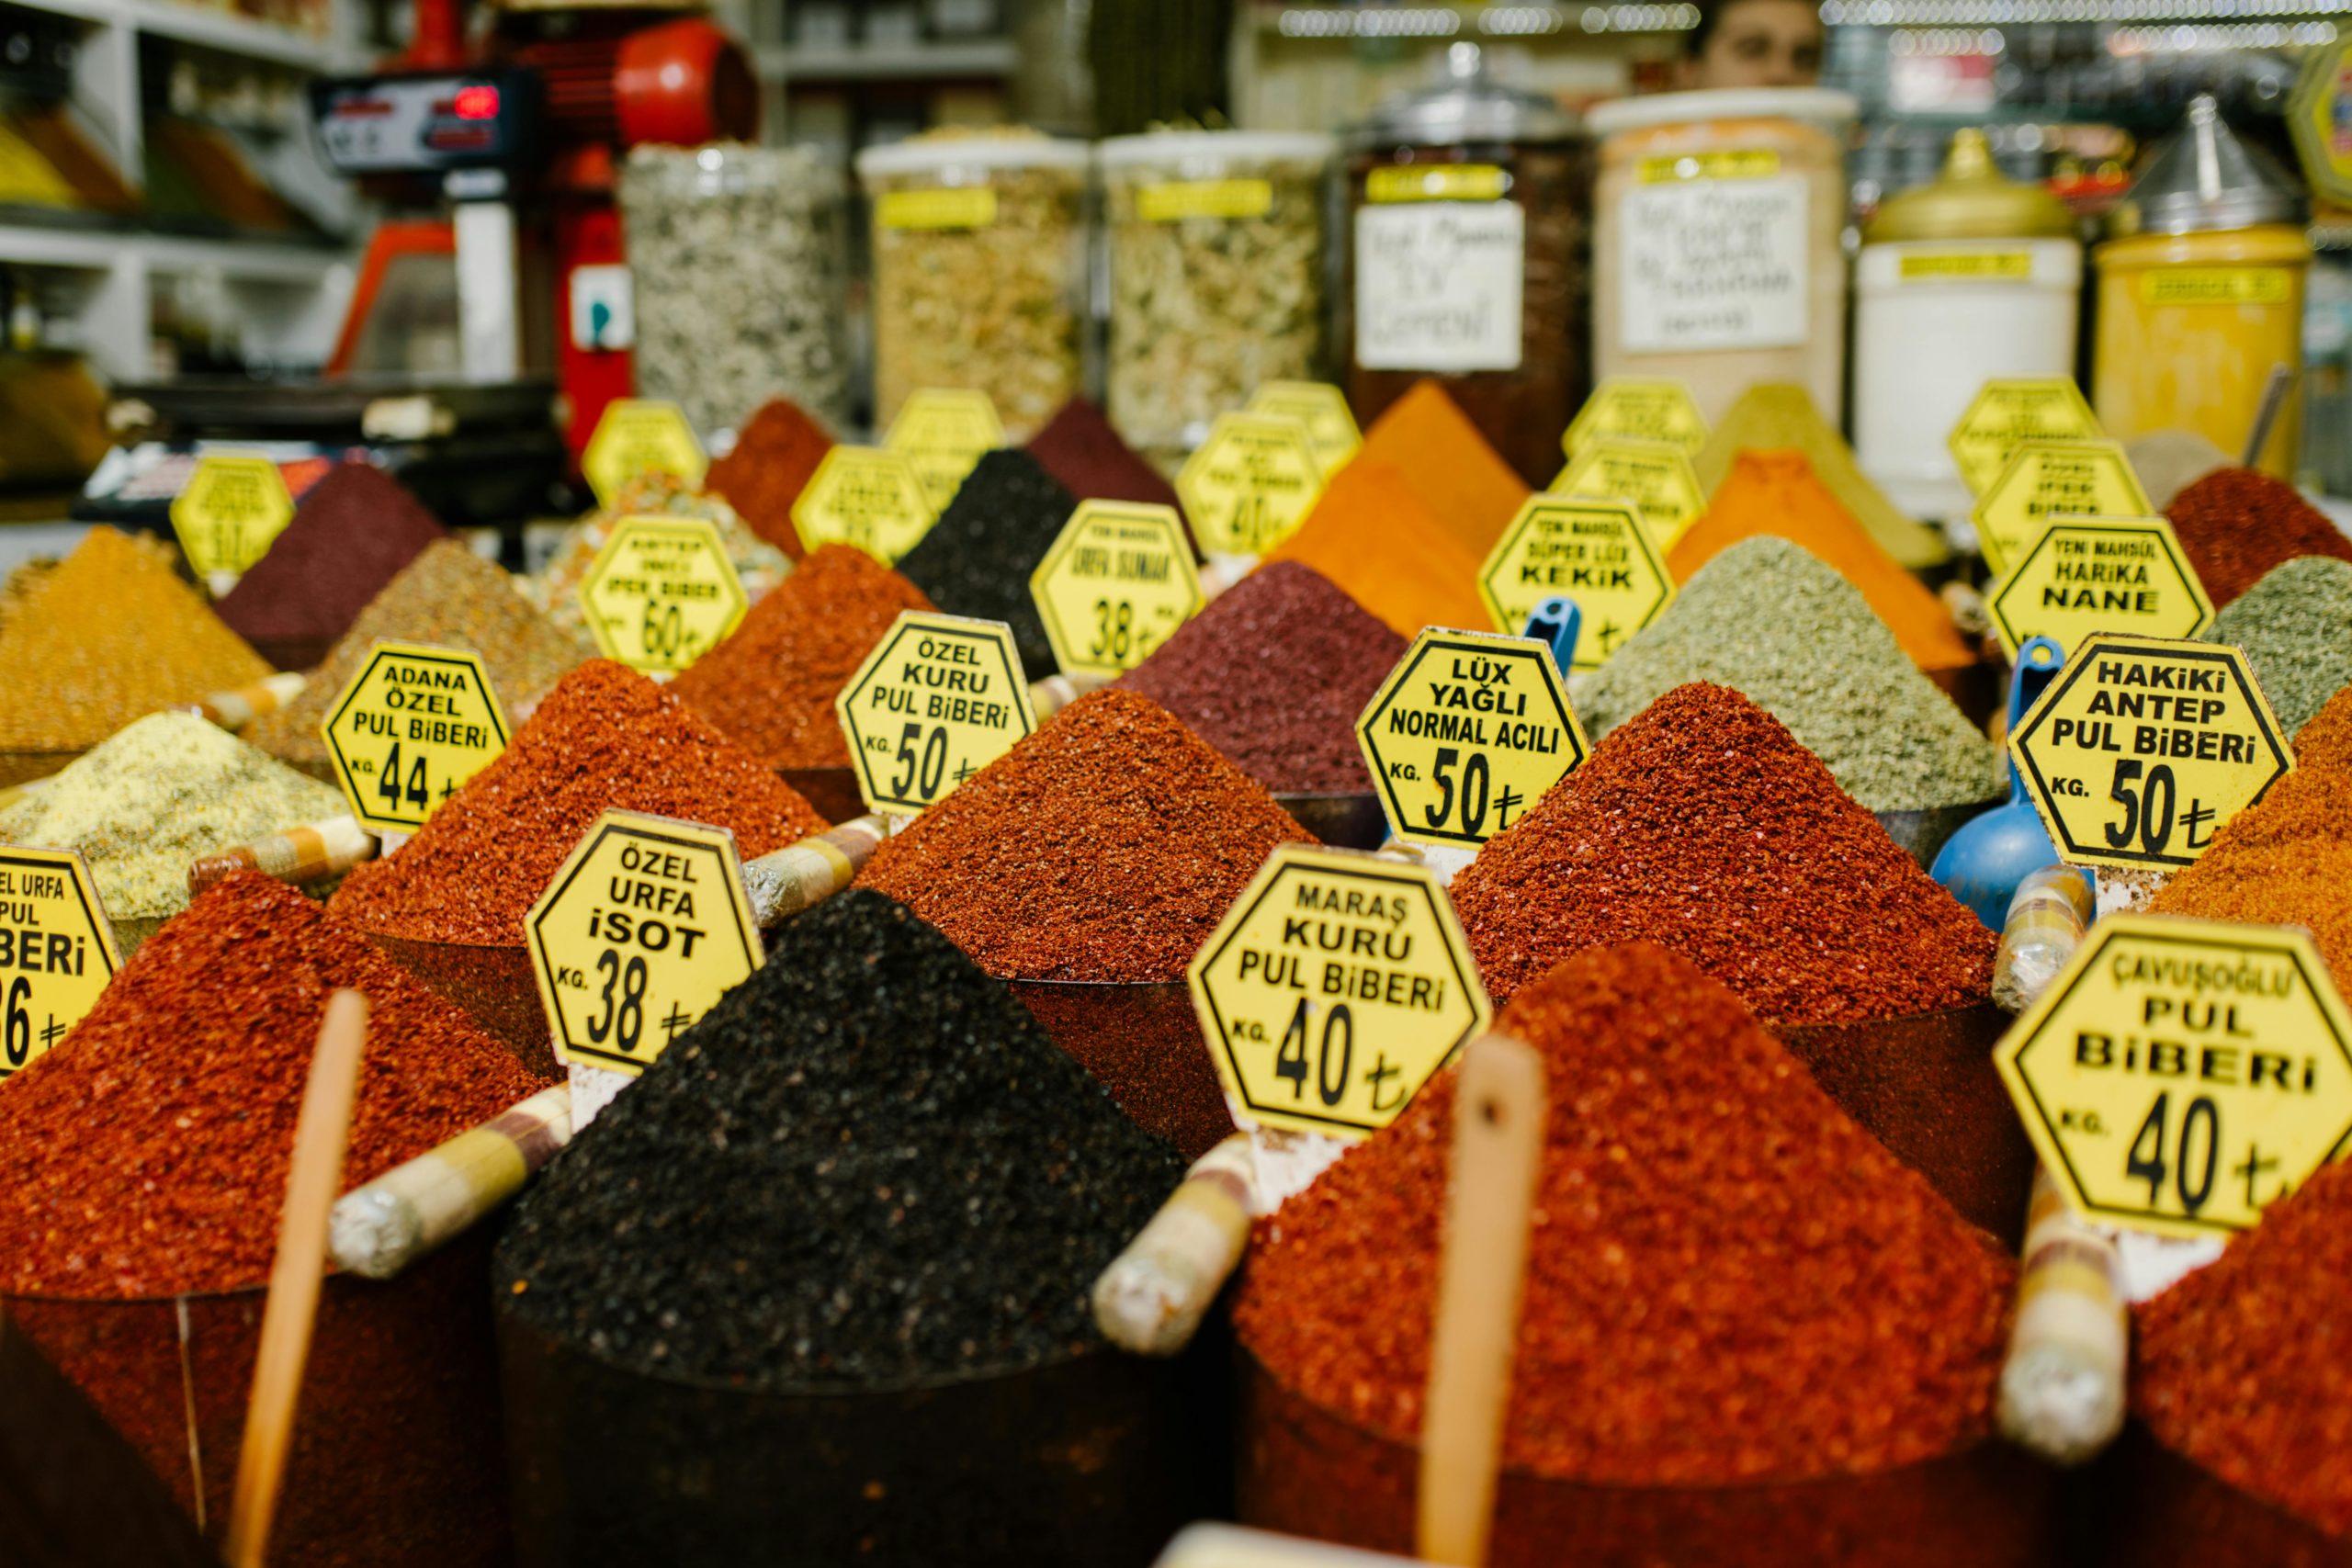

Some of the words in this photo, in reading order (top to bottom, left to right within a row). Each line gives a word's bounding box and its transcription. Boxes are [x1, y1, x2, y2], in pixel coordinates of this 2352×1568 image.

[2042, 587, 2158, 613] NANE
[643, 599, 681, 658] 60
[1091, 600, 1132, 660] 38
[918, 637, 980, 665] ÖZEL
[1452, 656, 1513, 685] LÜX
[383, 666, 467, 692] ADANA
[902, 662, 989, 694] KURU
[1430, 682, 1527, 716] YAĞLI
[386, 687, 462, 716] ÖZEL
[872, 686, 918, 715] PUL
[2086, 690, 2226, 724] ANTEP
[354, 711, 400, 737] PUL
[1389, 708, 1488, 745] NORMAL
[1495, 721, 1560, 754] ACILI
[2052, 718, 2121, 751] PUL
[379, 741, 428, 811] 44
[892, 723, 948, 800] 50
[1389, 762, 1421, 782] KG.
[1425, 747, 1490, 836] 50
[2051, 777, 2090, 797] KG.
[2104, 759, 2177, 853] 50
[621, 841, 697, 884] ÖZEL
[22, 873, 64, 900] URFA
[609, 877, 695, 919] URFA
[1295, 883, 1408, 927] MARAŞ
[0, 900, 40, 926] PUL
[1283, 917, 1412, 961] KURU
[1238, 950, 1306, 989] PUL
[2112, 951, 2297, 998] ÇAVUŞOĞLU
[0, 976, 32, 1067] 6
[587, 948, 648, 1053] 38
[2143, 996, 2256, 1039] PUL
[1274, 996, 1353, 1107] 40
[2125, 1089, 2220, 1219] 40
